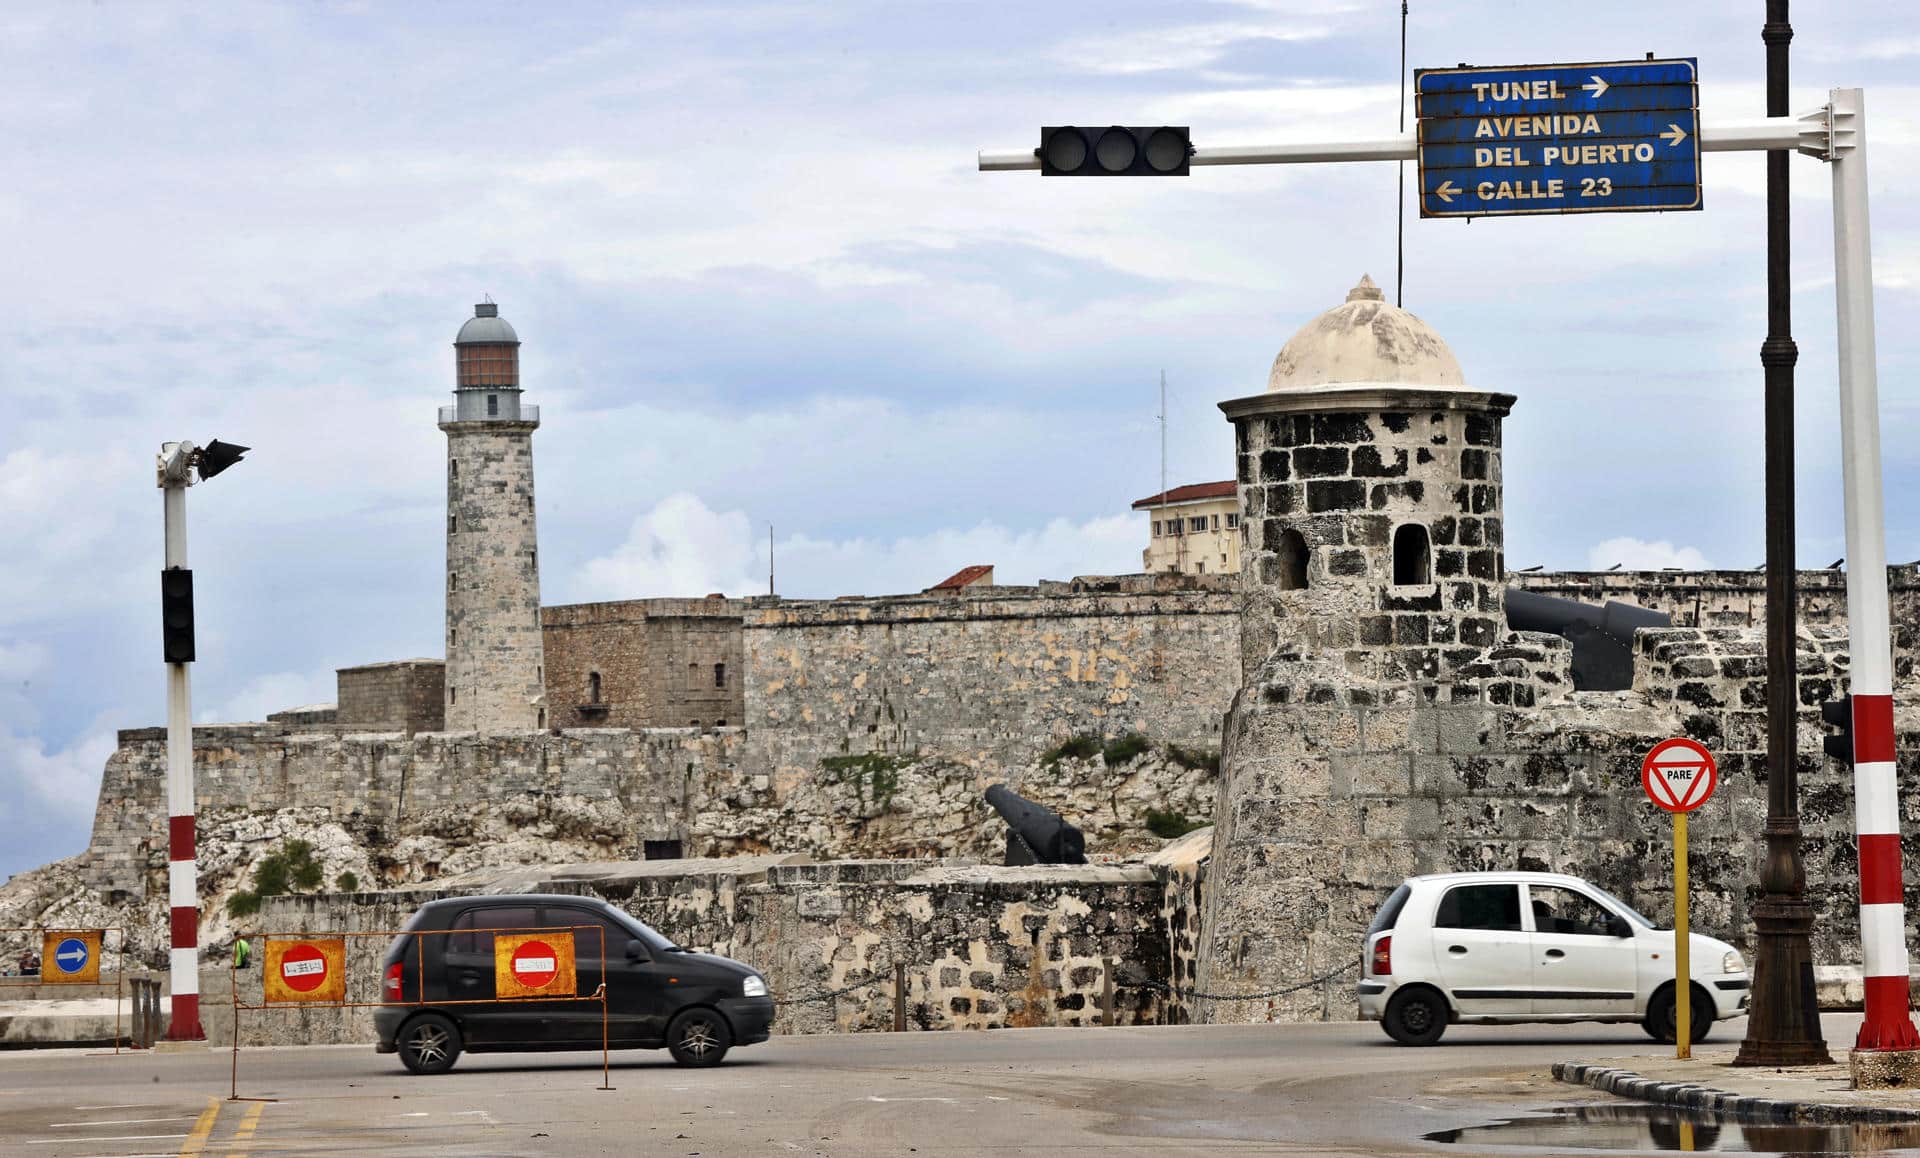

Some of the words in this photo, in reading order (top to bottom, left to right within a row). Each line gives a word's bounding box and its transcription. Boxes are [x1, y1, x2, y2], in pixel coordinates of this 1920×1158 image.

[1471, 80, 1566, 102] TUNEL
[1474, 114, 1601, 138] AVENIDA
[1475, 147, 1530, 167] DEL
[1544, 143, 1655, 166] PUERTO
[1477, 180, 1564, 200] CALLE
[1580, 178, 1613, 197] 23
[1667, 770, 1692, 780] PARE
